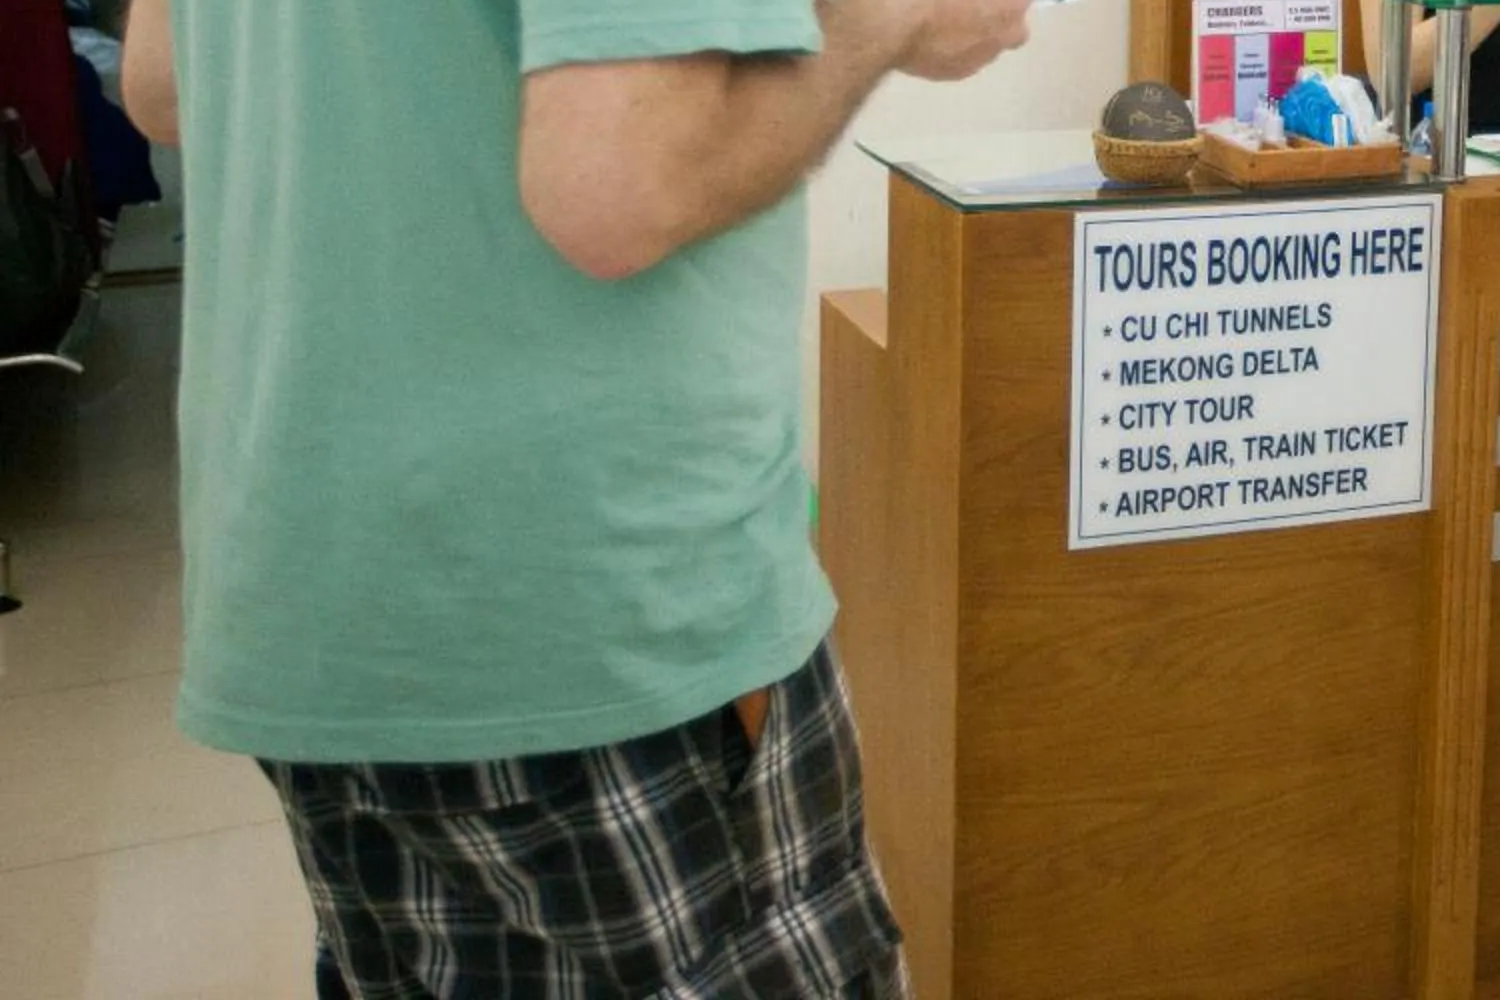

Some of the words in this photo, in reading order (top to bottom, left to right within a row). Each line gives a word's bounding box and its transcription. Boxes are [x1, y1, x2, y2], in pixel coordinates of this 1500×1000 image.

[1094, 240, 1198, 293] TOURS
[1207, 232, 1342, 286] BOOKING
[1350, 227, 1425, 276] HERE
[1120, 315, 1157, 342] CU
[1165, 311, 1209, 339] CHI
[1216, 303, 1333, 335] TUNNELS
[1119, 353, 1234, 386] MEKONG
[1242, 346, 1319, 377] DELTA
[1119, 401, 1178, 430] CITY
[1184, 395, 1254, 424] TOUR
[1118, 445, 1178, 473] BUS,
[1185, 439, 1235, 472] AIR,
[1243, 431, 1316, 461] TRAIN
[1324, 421, 1408, 453] TICKET
[1115, 481, 1230, 518] AIRPORT
[1237, 467, 1368, 505] TRANSFER
